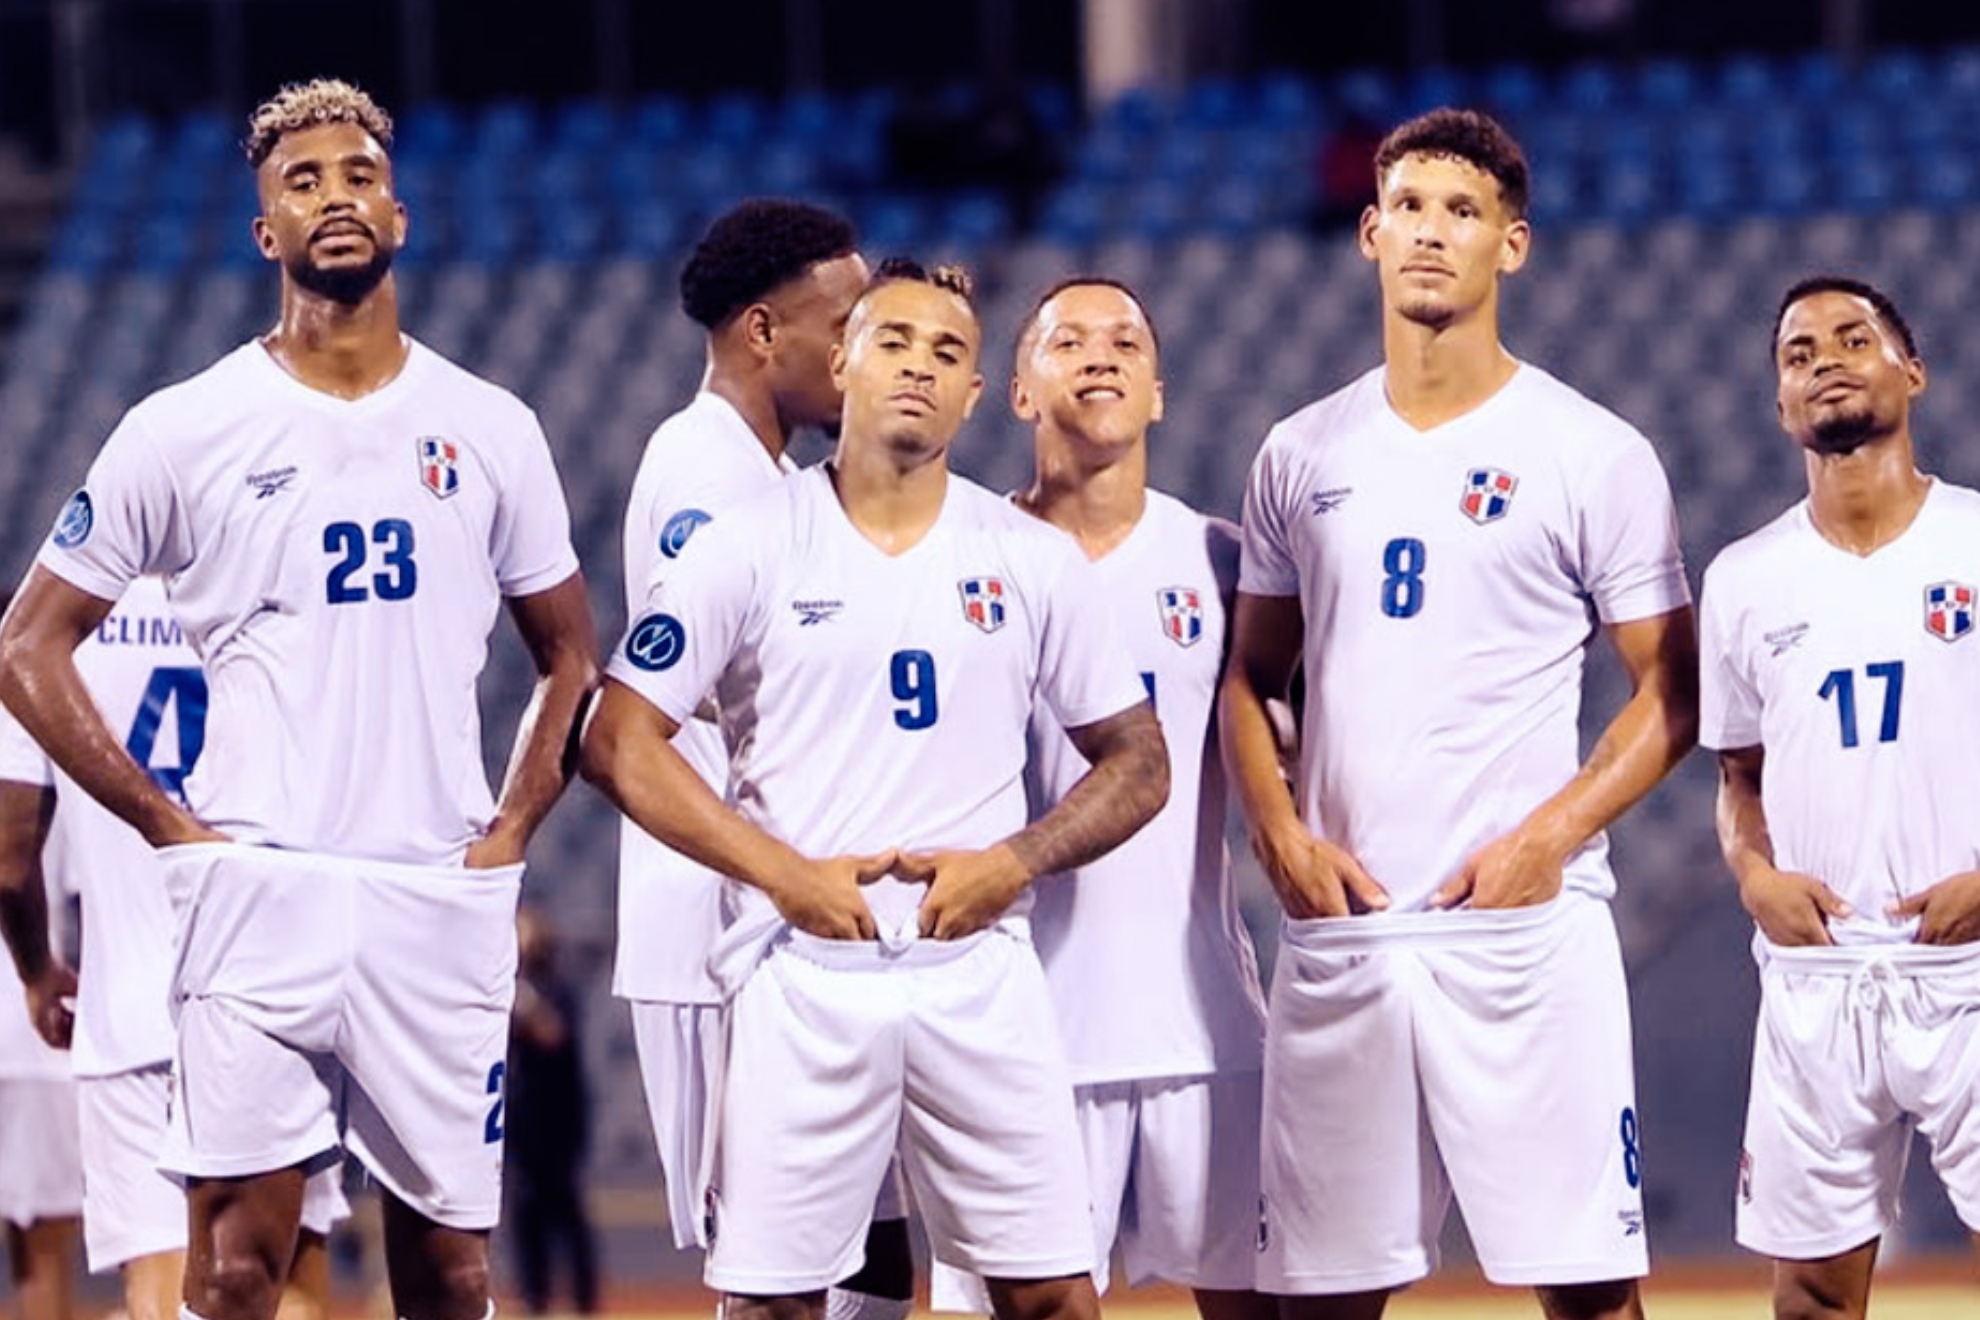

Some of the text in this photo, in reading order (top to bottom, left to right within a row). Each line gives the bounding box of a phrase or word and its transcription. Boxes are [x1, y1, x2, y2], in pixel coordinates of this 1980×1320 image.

[324, 519, 417, 605] 23
[1382, 538, 1426, 619] 8
[890, 650, 939, 731] 9
[1818, 660, 1905, 748] 17
[126, 666, 209, 803] 4
[1620, 1106, 1640, 1189] 8
